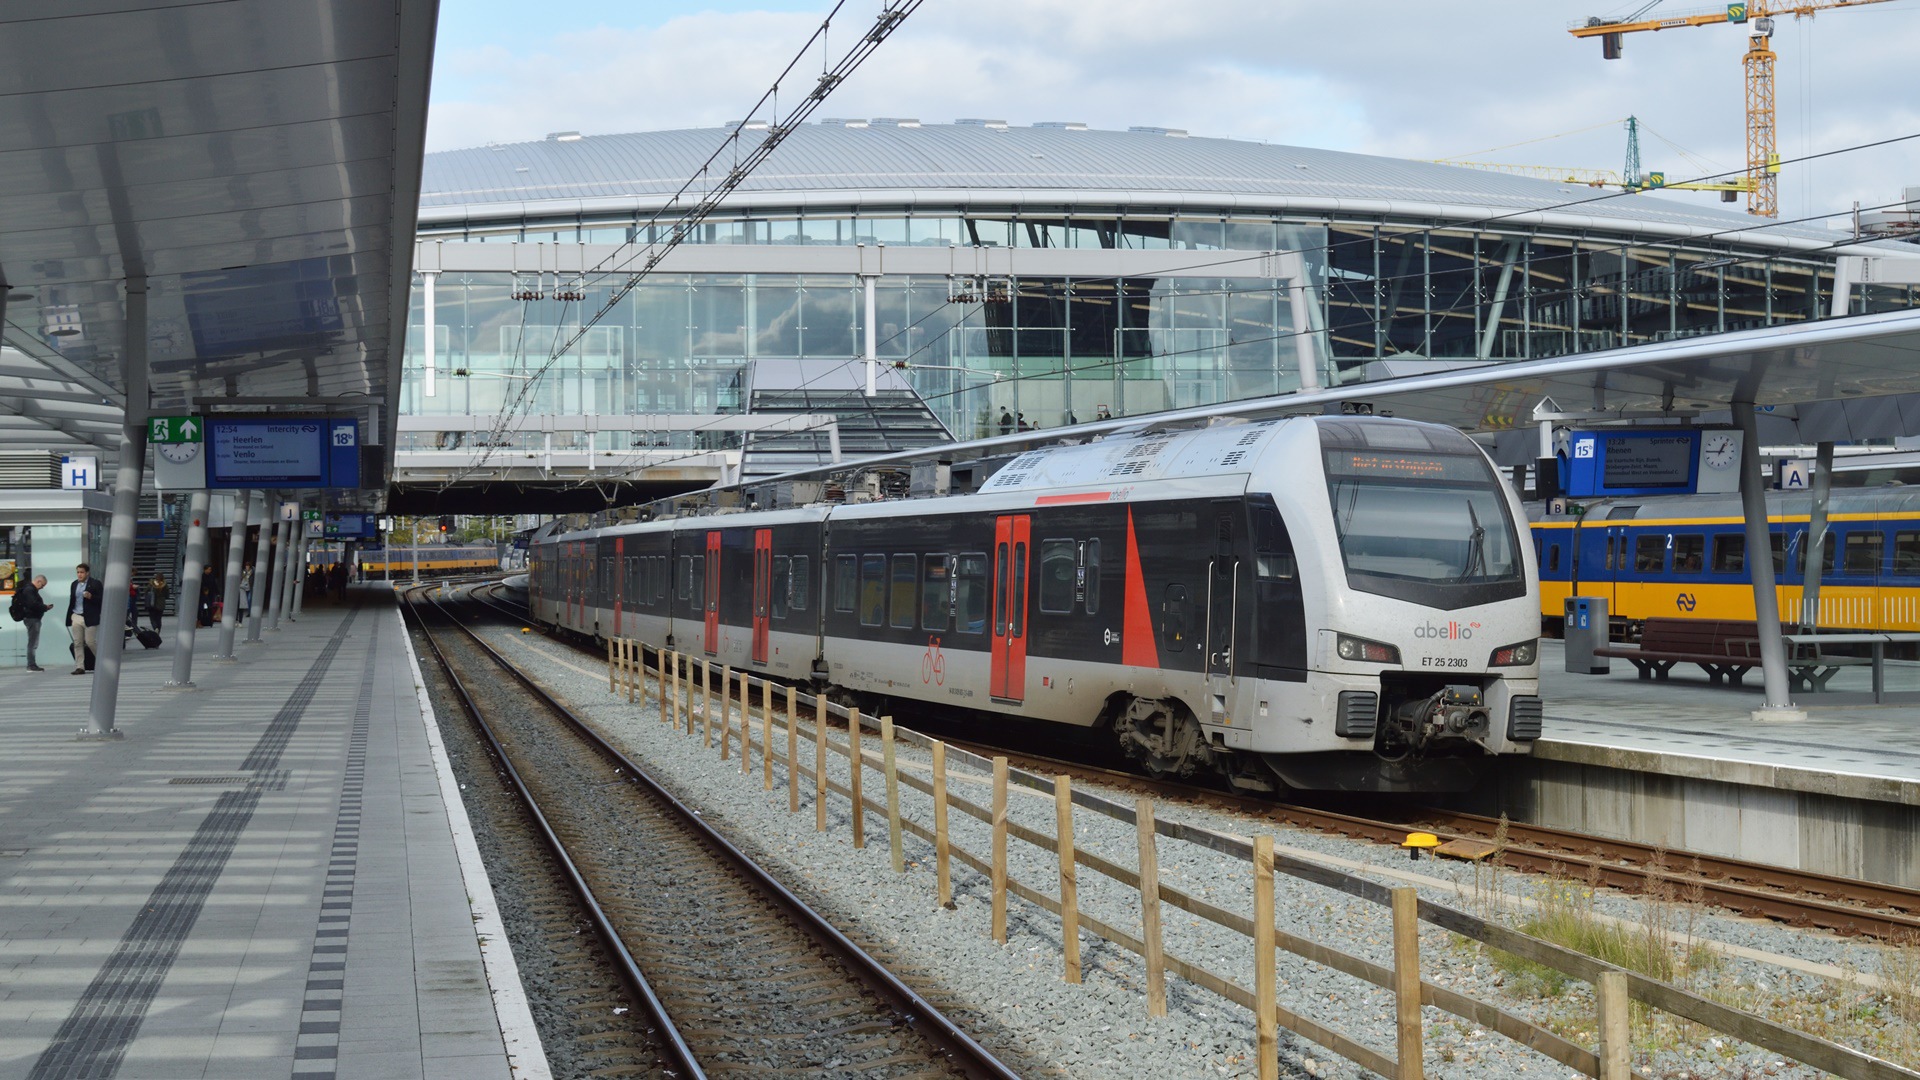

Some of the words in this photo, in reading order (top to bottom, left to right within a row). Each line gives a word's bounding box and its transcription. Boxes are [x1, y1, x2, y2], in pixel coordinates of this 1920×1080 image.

[217, 425, 238, 433] 12:54
[267, 425, 300, 434] Intercity
[233, 435, 263, 443] Heerlen
[1608, 438, 1625, 446] 13:28
[1650, 437, 1675, 446] Sprinter
[233, 450, 255, 458] Venlo
[1606, 446, 1632, 454] Rhenen
[72, 468, 86, 486] H
[1788, 470, 1803, 486] A
[286, 508, 292, 519] J
[1554, 504, 1561, 513] B
[313, 524, 320, 532] K
[1666, 534, 1673, 549] 2
[1078, 542, 1084, 566] 1
[951, 557, 957, 578] 2
[1414, 621, 1472, 640] abellio
[1422, 657, 1433, 667] ET
[1435, 657, 1445, 667] 25
[1447, 657, 1468, 668] 2303
